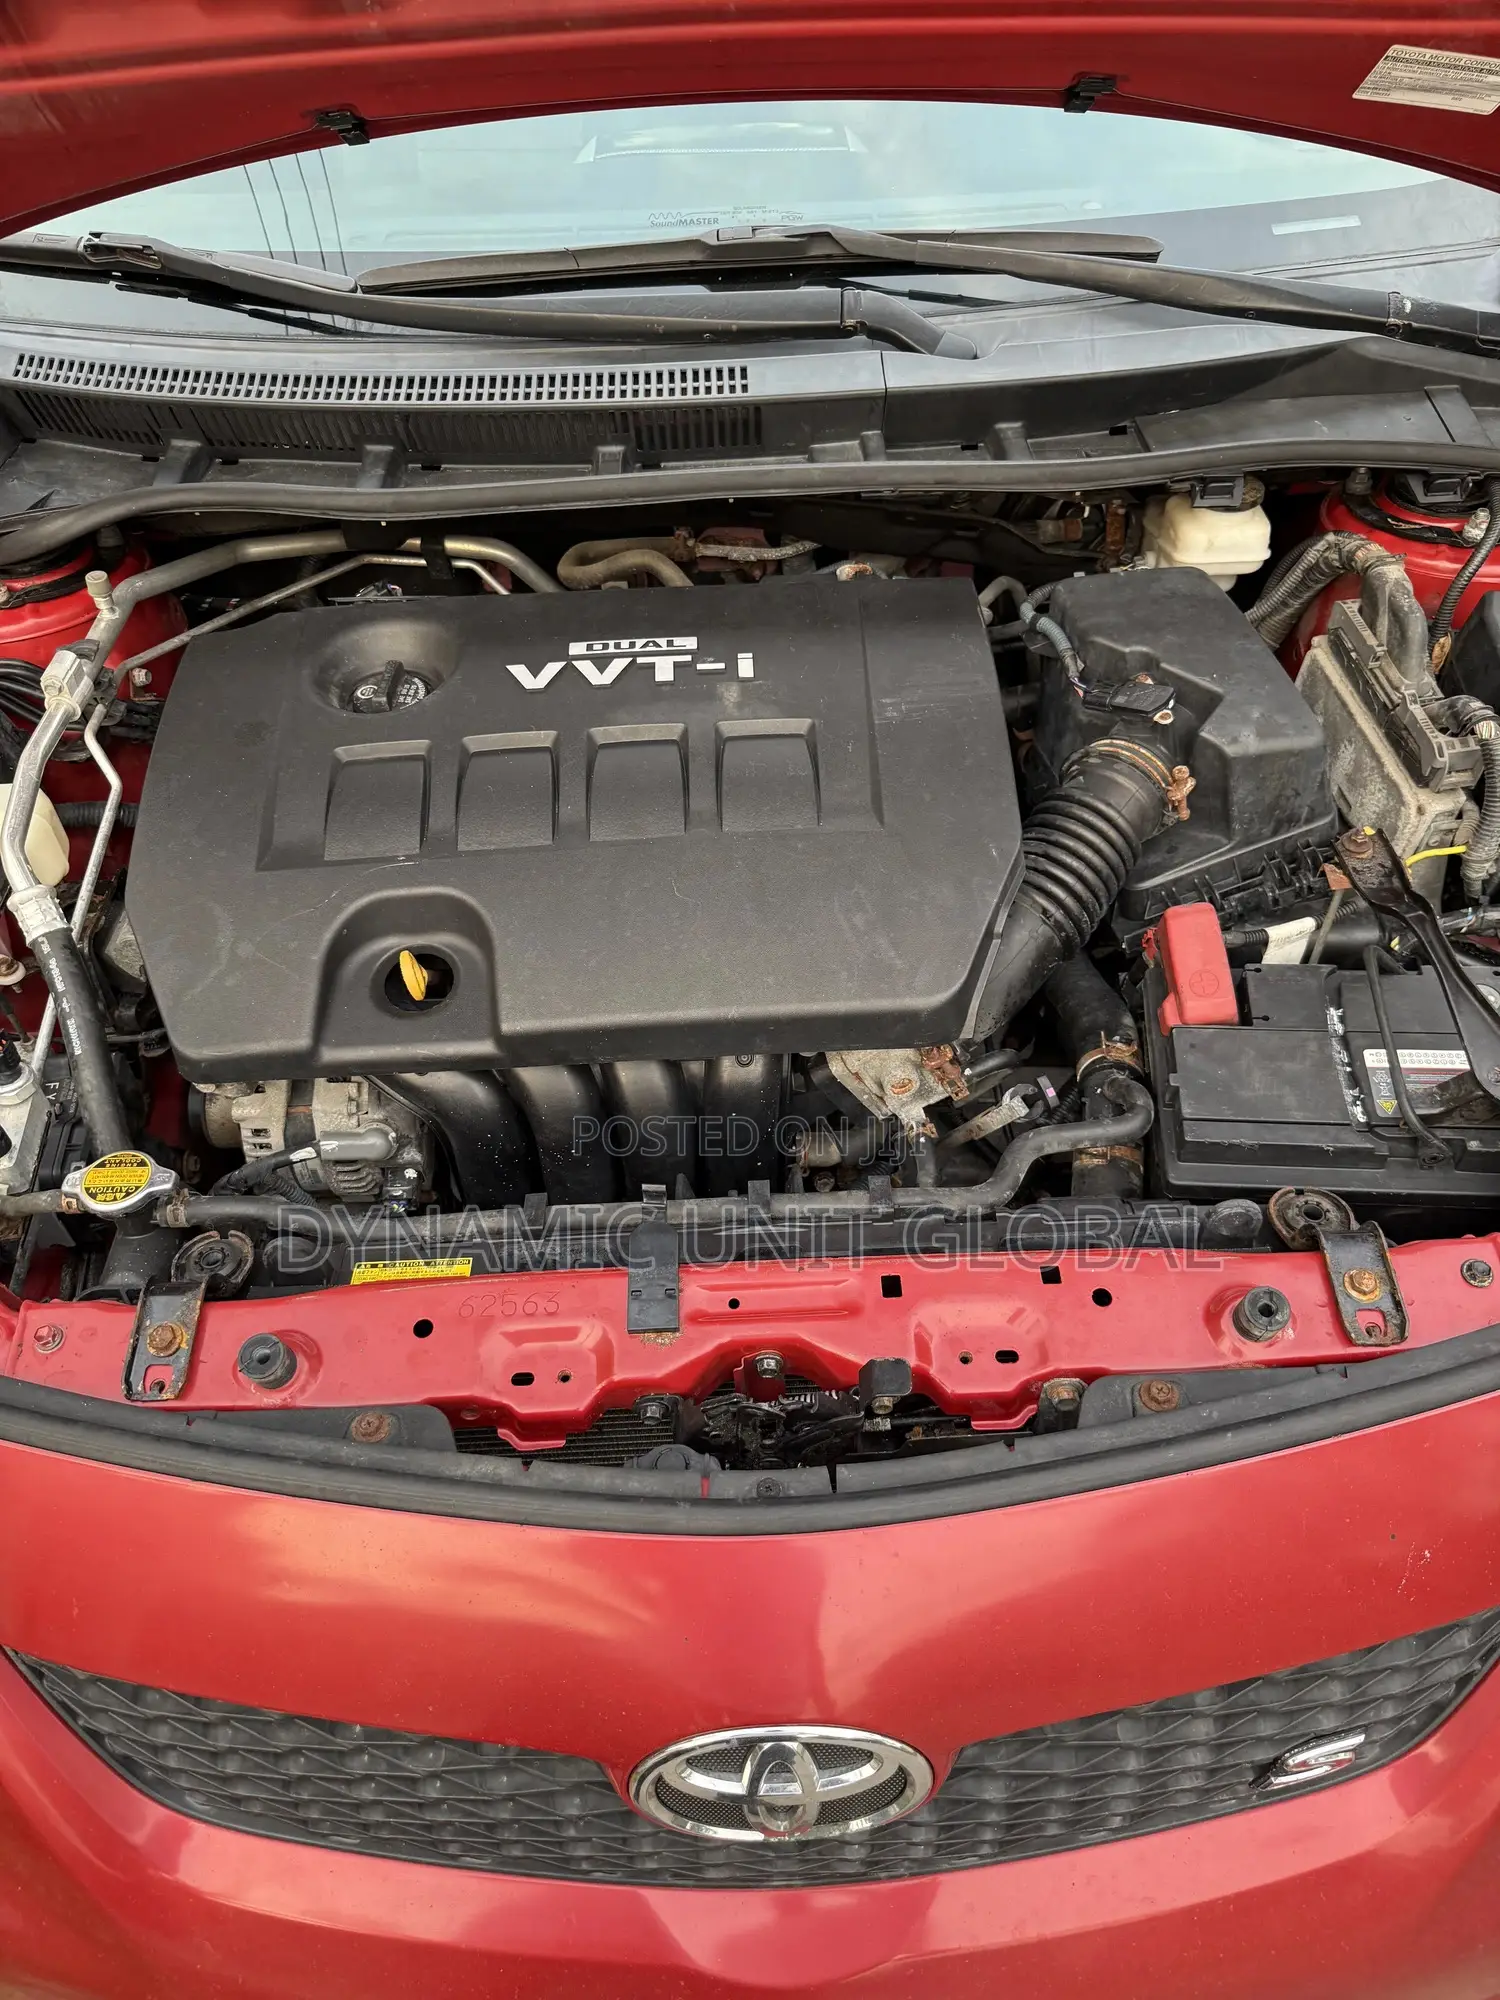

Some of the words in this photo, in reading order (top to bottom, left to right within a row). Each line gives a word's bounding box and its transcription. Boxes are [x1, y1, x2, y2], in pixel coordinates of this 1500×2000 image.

[1390, 49, 1426, 59] TOYOTA
[1428, 54, 1463, 64] MOTOR
[650, 217, 720, 228] SoundMASTER
[586, 639, 687, 652] DUAL
[505, 652, 755, 690] VVT-i
[458, 1290, 560, 1318] 62563
